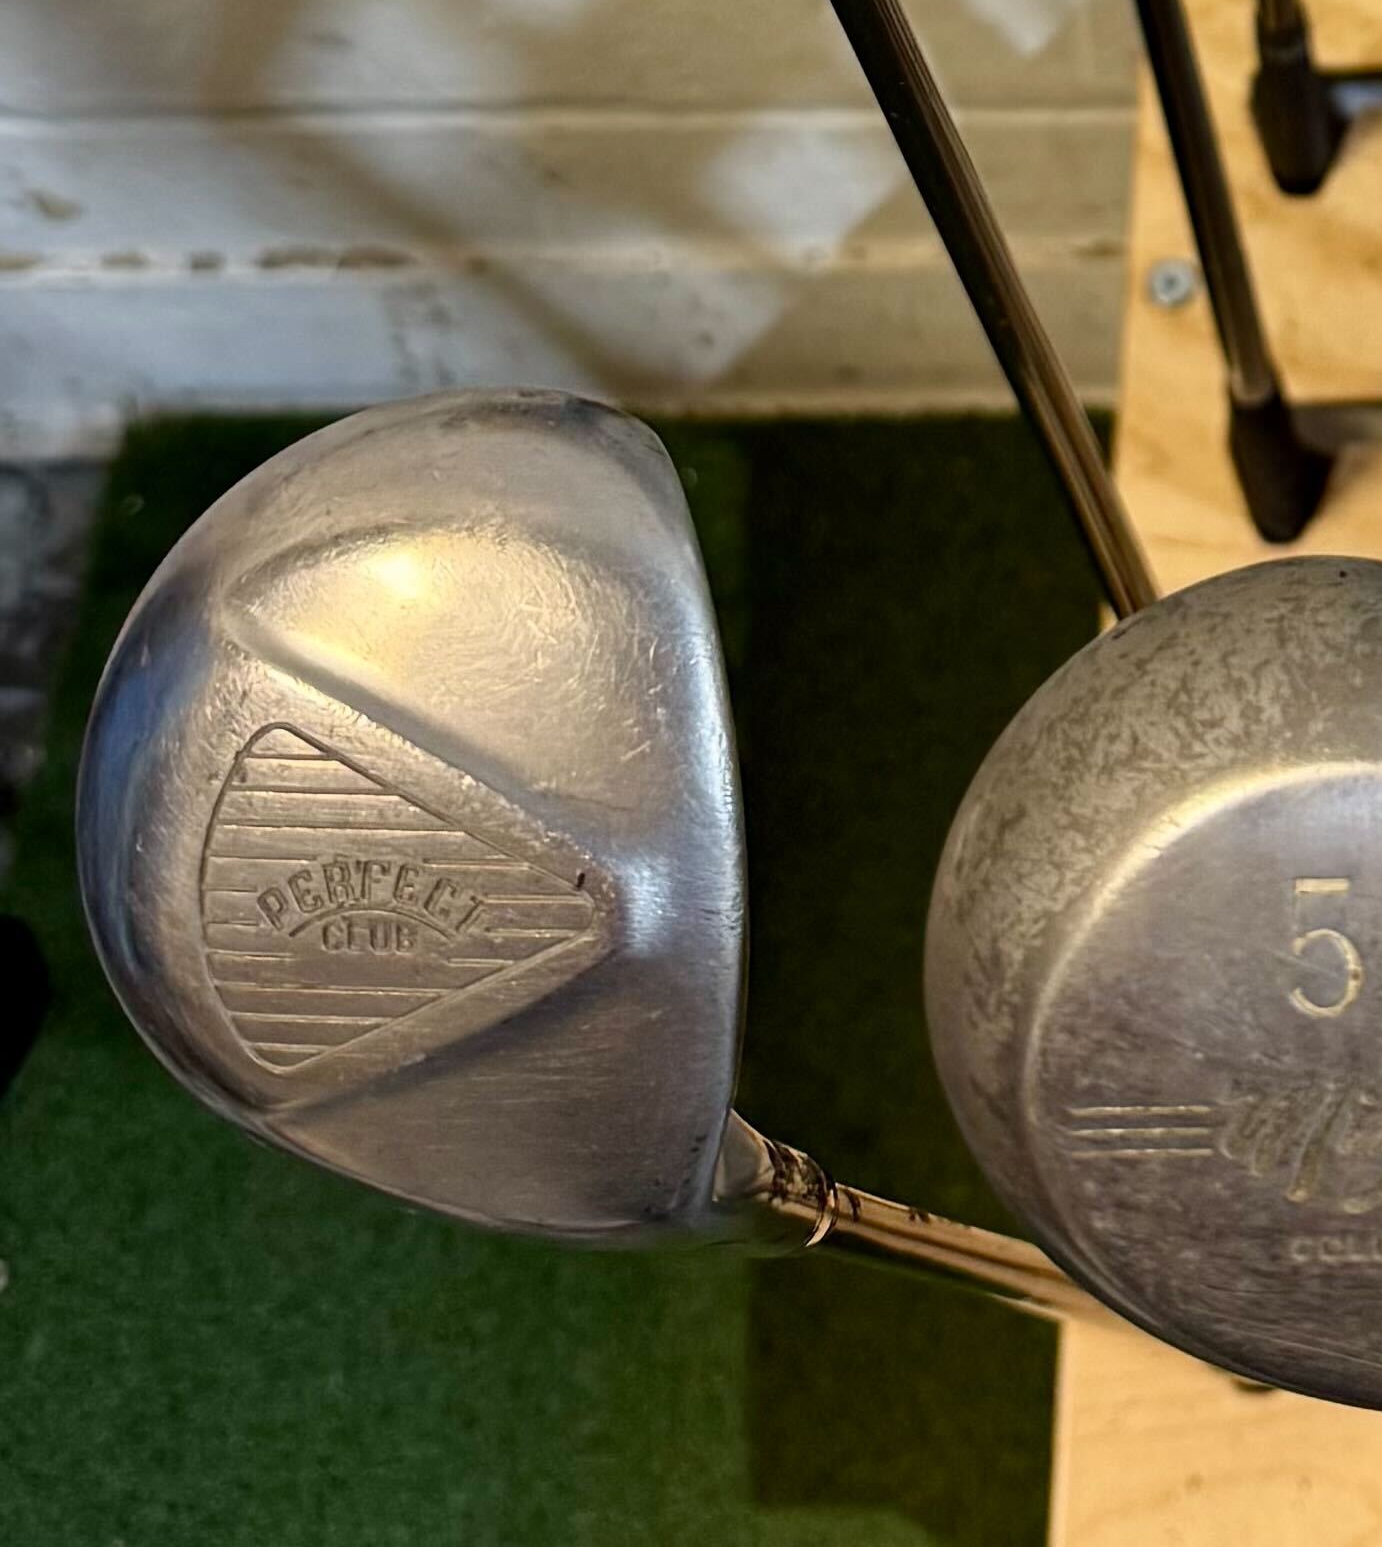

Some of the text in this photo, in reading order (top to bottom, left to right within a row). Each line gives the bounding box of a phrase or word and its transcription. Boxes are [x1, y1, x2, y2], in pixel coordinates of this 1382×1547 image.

[256, 858, 484, 932] PERFECT
[322, 917, 416, 955] CLUB
[1288, 878, 1363, 1020] 5
